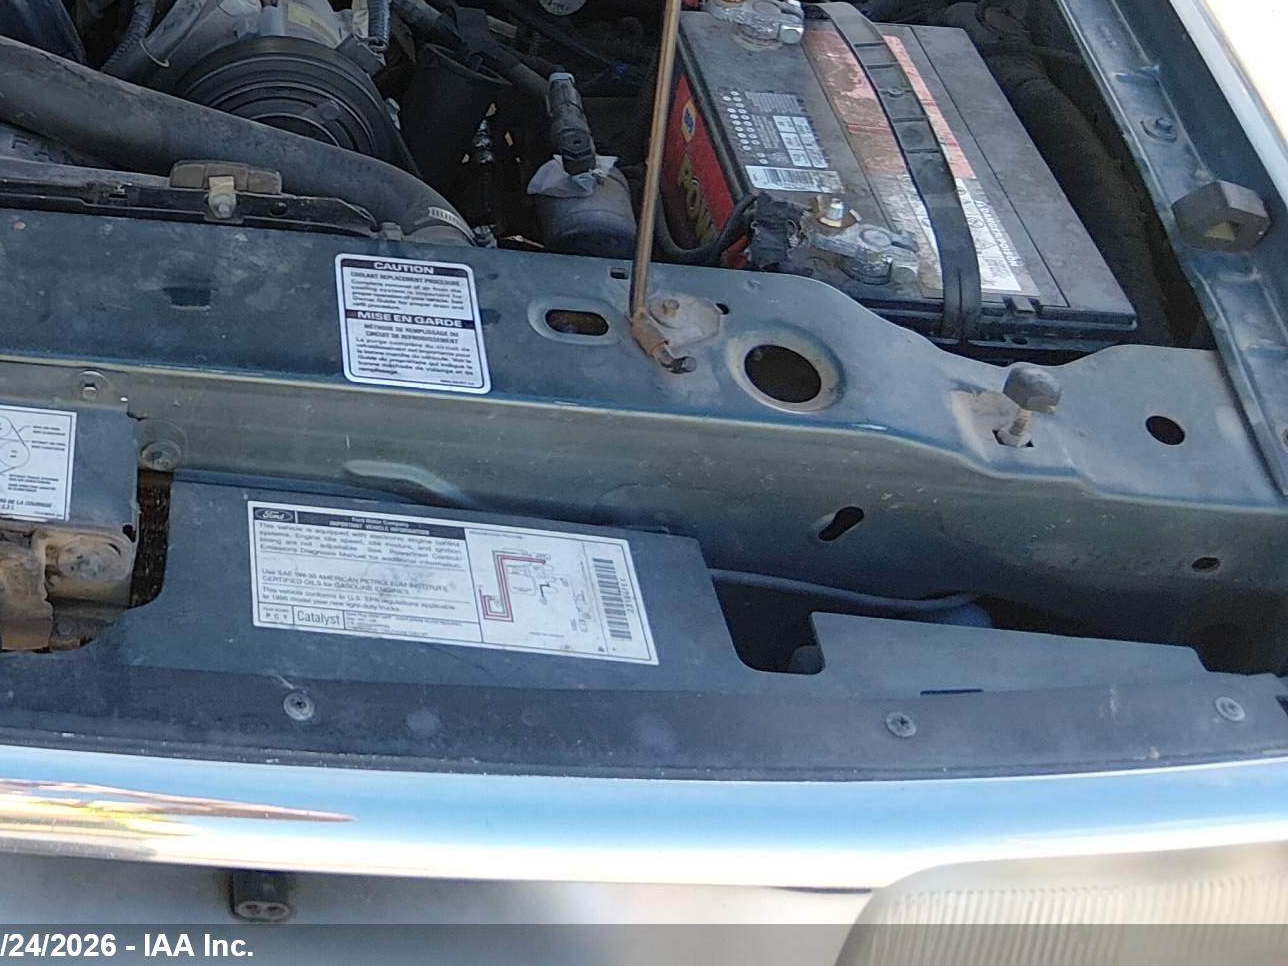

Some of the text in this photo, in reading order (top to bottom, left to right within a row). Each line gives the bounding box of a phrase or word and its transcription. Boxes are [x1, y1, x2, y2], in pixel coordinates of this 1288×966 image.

[373, 261, 435, 274] CAUTION
[357, 311, 463, 328] MISE EN GARDE
[297, 610, 340, 627] Catalyst
